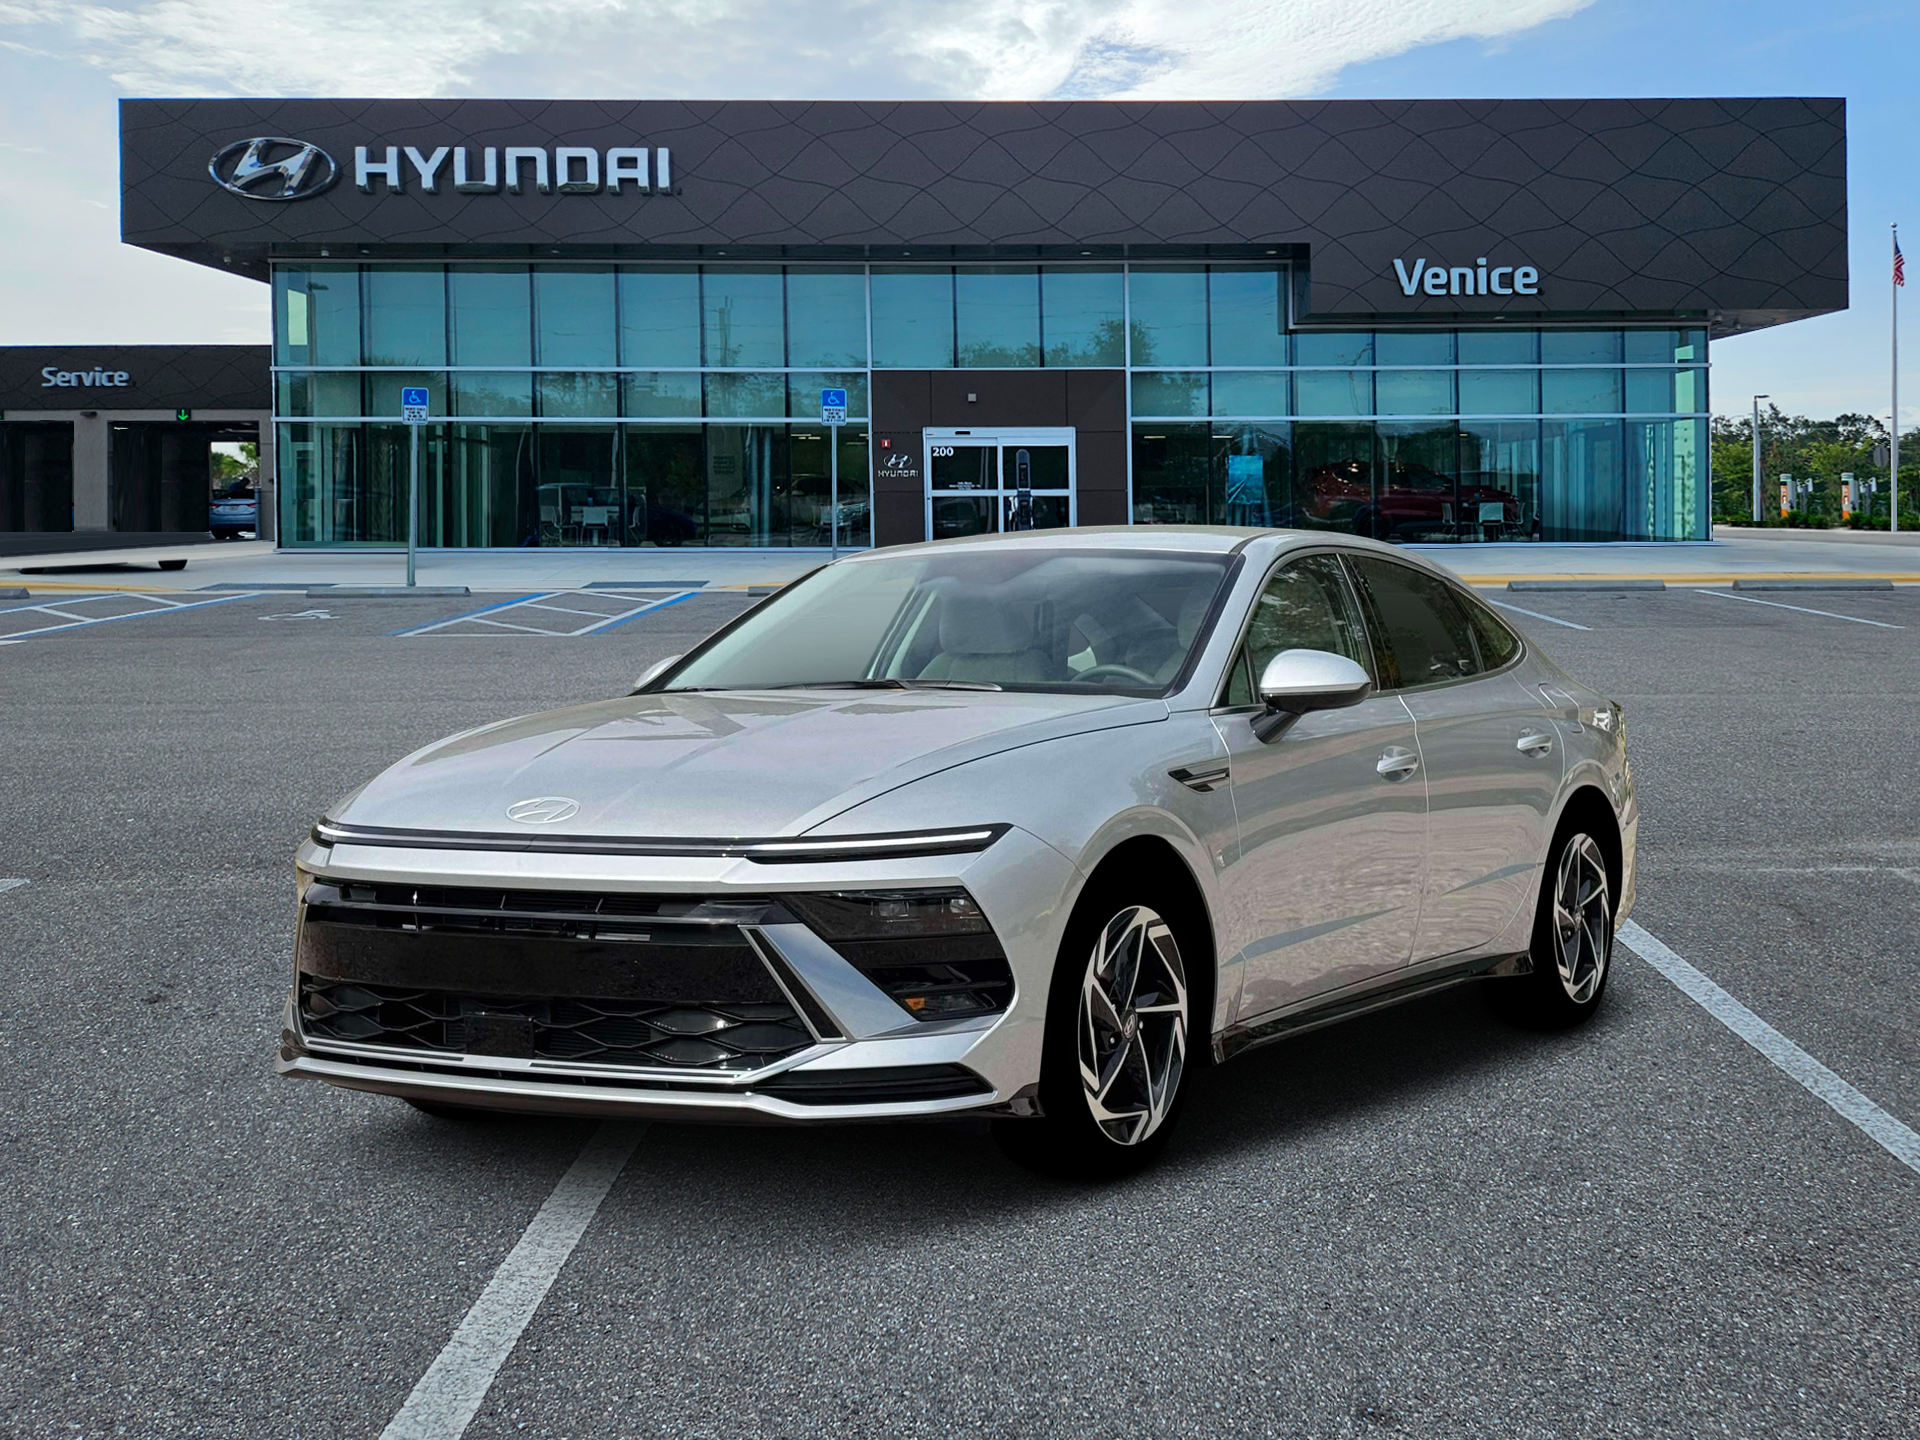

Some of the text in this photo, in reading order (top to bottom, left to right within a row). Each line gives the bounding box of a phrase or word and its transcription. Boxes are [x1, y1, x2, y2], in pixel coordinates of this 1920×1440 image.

[354, 146, 671, 194] HYUNDAI
[1392, 257, 1539, 296] Venice
[41, 366, 130, 387] Service
[932, 446, 954, 457] 200
[877, 469, 919, 478] HYUNDAI
